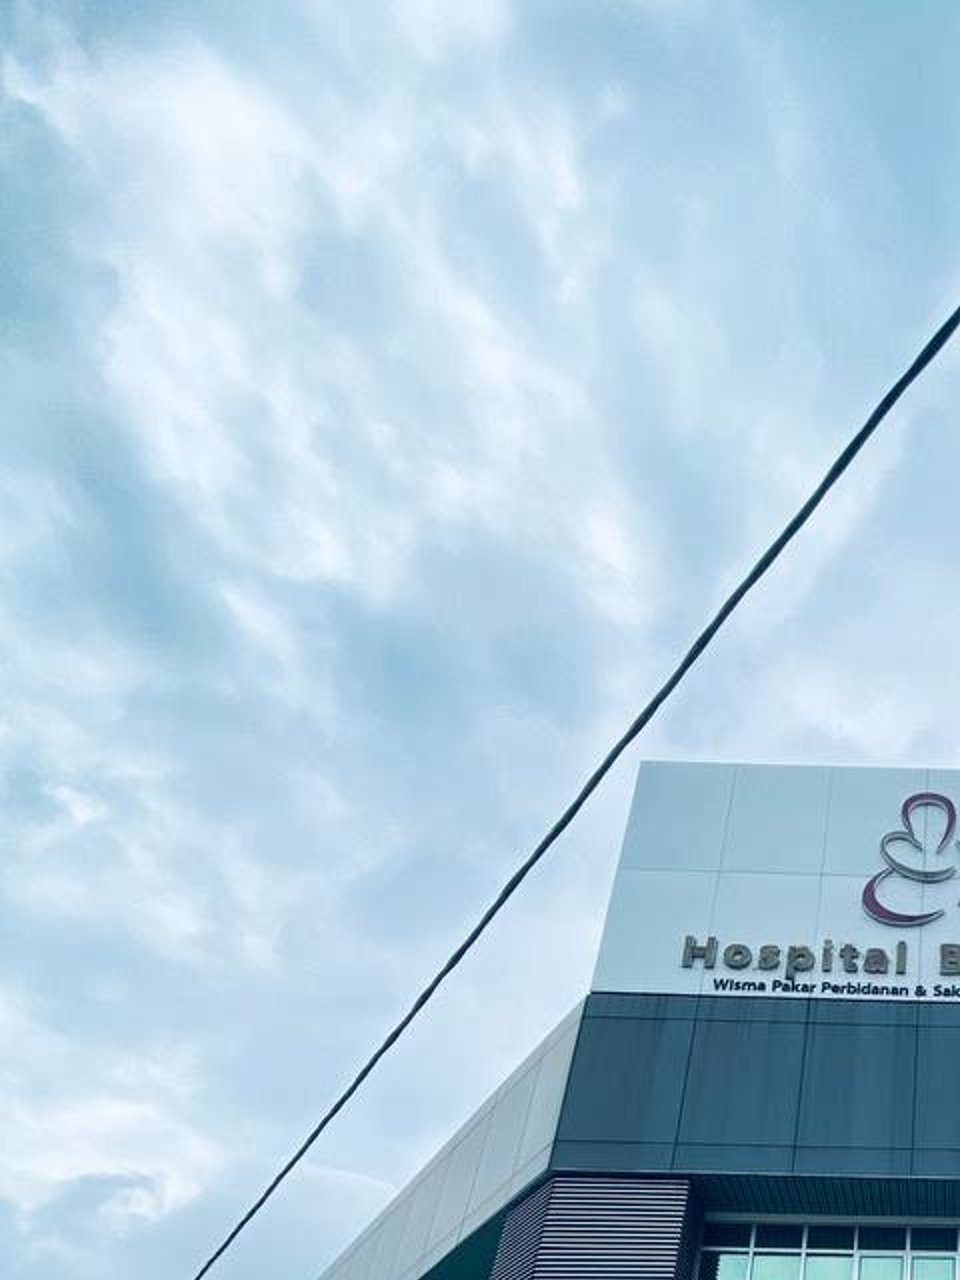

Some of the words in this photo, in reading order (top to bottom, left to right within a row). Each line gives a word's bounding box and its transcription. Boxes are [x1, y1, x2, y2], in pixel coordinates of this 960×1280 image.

[681, 935, 908, 981] Hospital
[713, 977, 766, 991] Wisma
[771, 978, 817, 993] Pakar
[821, 981, 909, 996] Perbidanan
[914, 984, 927, 997] &
